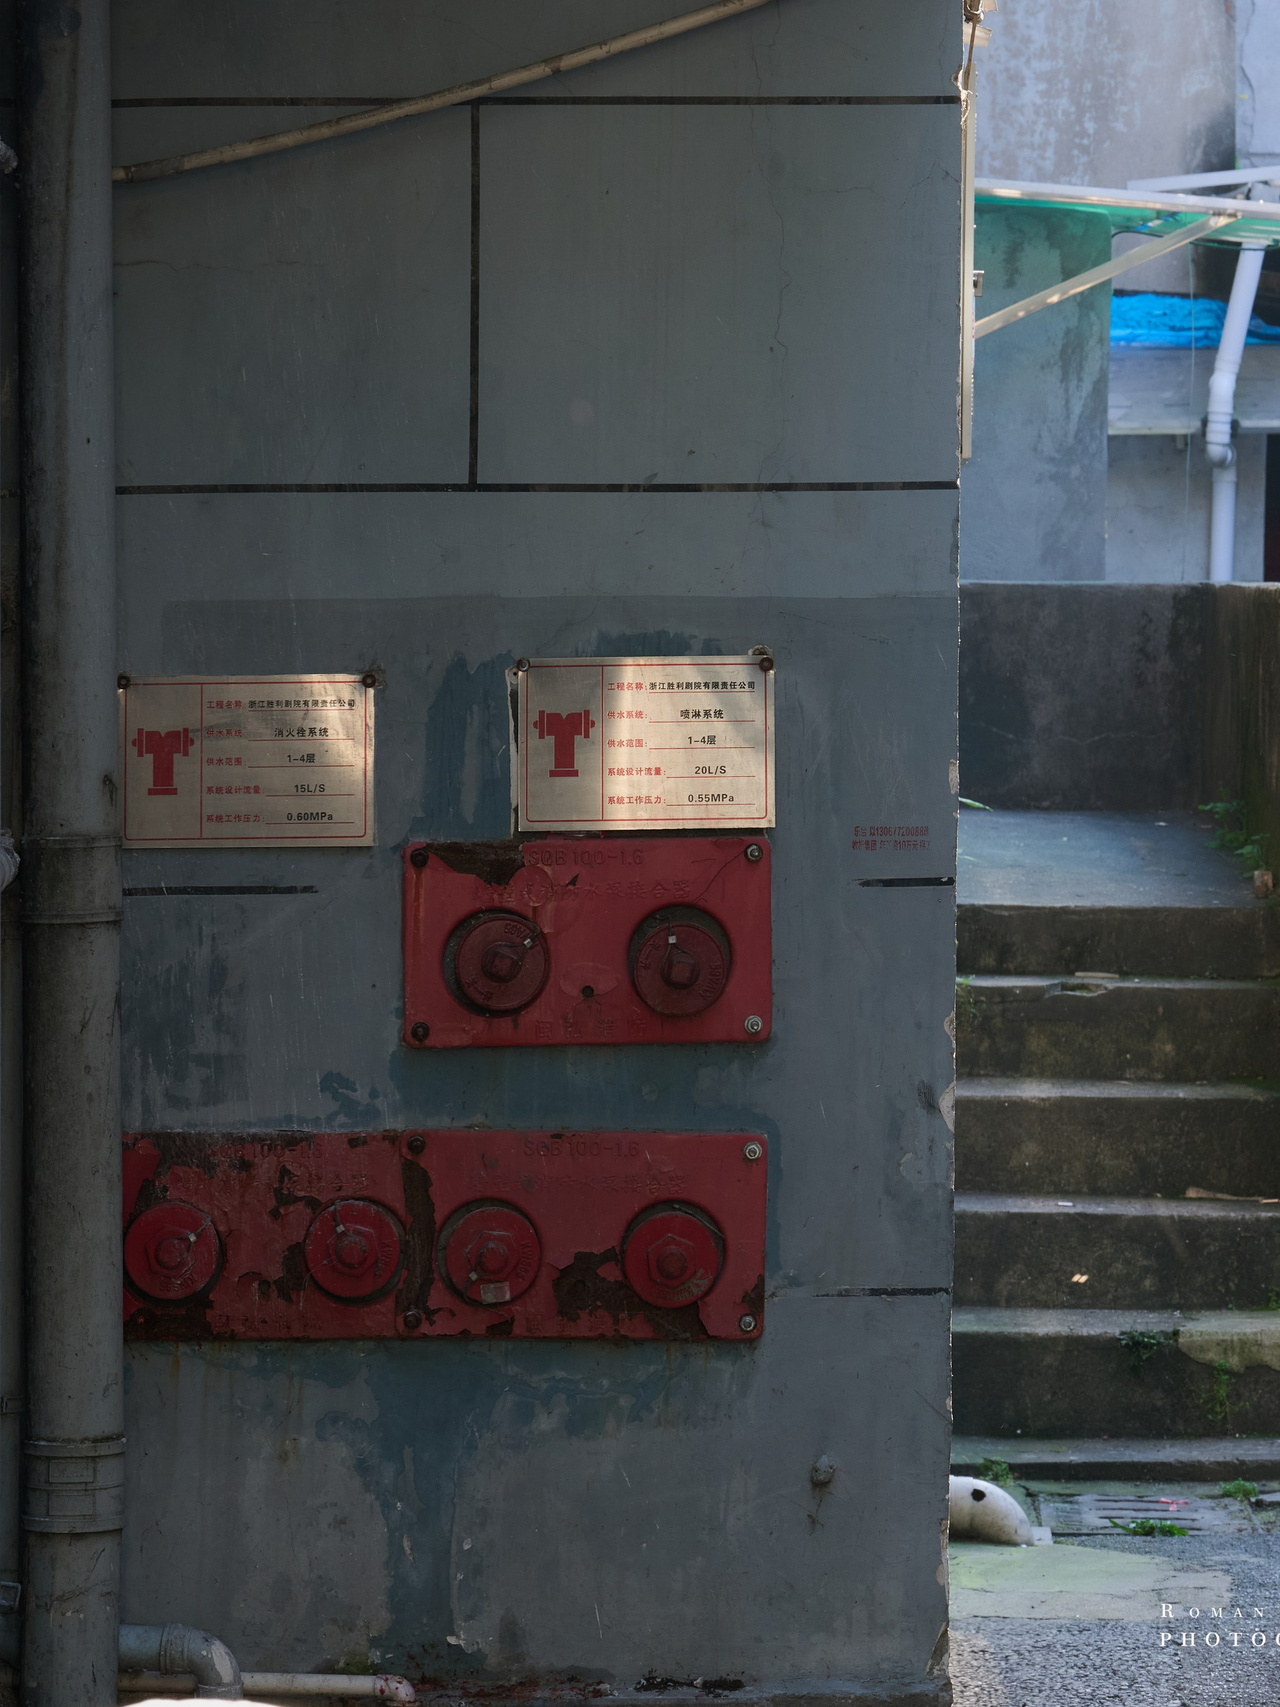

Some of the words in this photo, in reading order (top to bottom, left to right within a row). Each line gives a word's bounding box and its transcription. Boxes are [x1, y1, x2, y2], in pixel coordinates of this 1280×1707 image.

[679, 708, 724, 719] 喷淋系统
[273, 727, 329, 738] 消火栓系统
[694, 765, 727, 775] 20L/S
[294, 783, 326, 793] 15L/S
[687, 793, 735, 804] 0.55MPa
[286, 812, 334, 822] 0.60MPa
